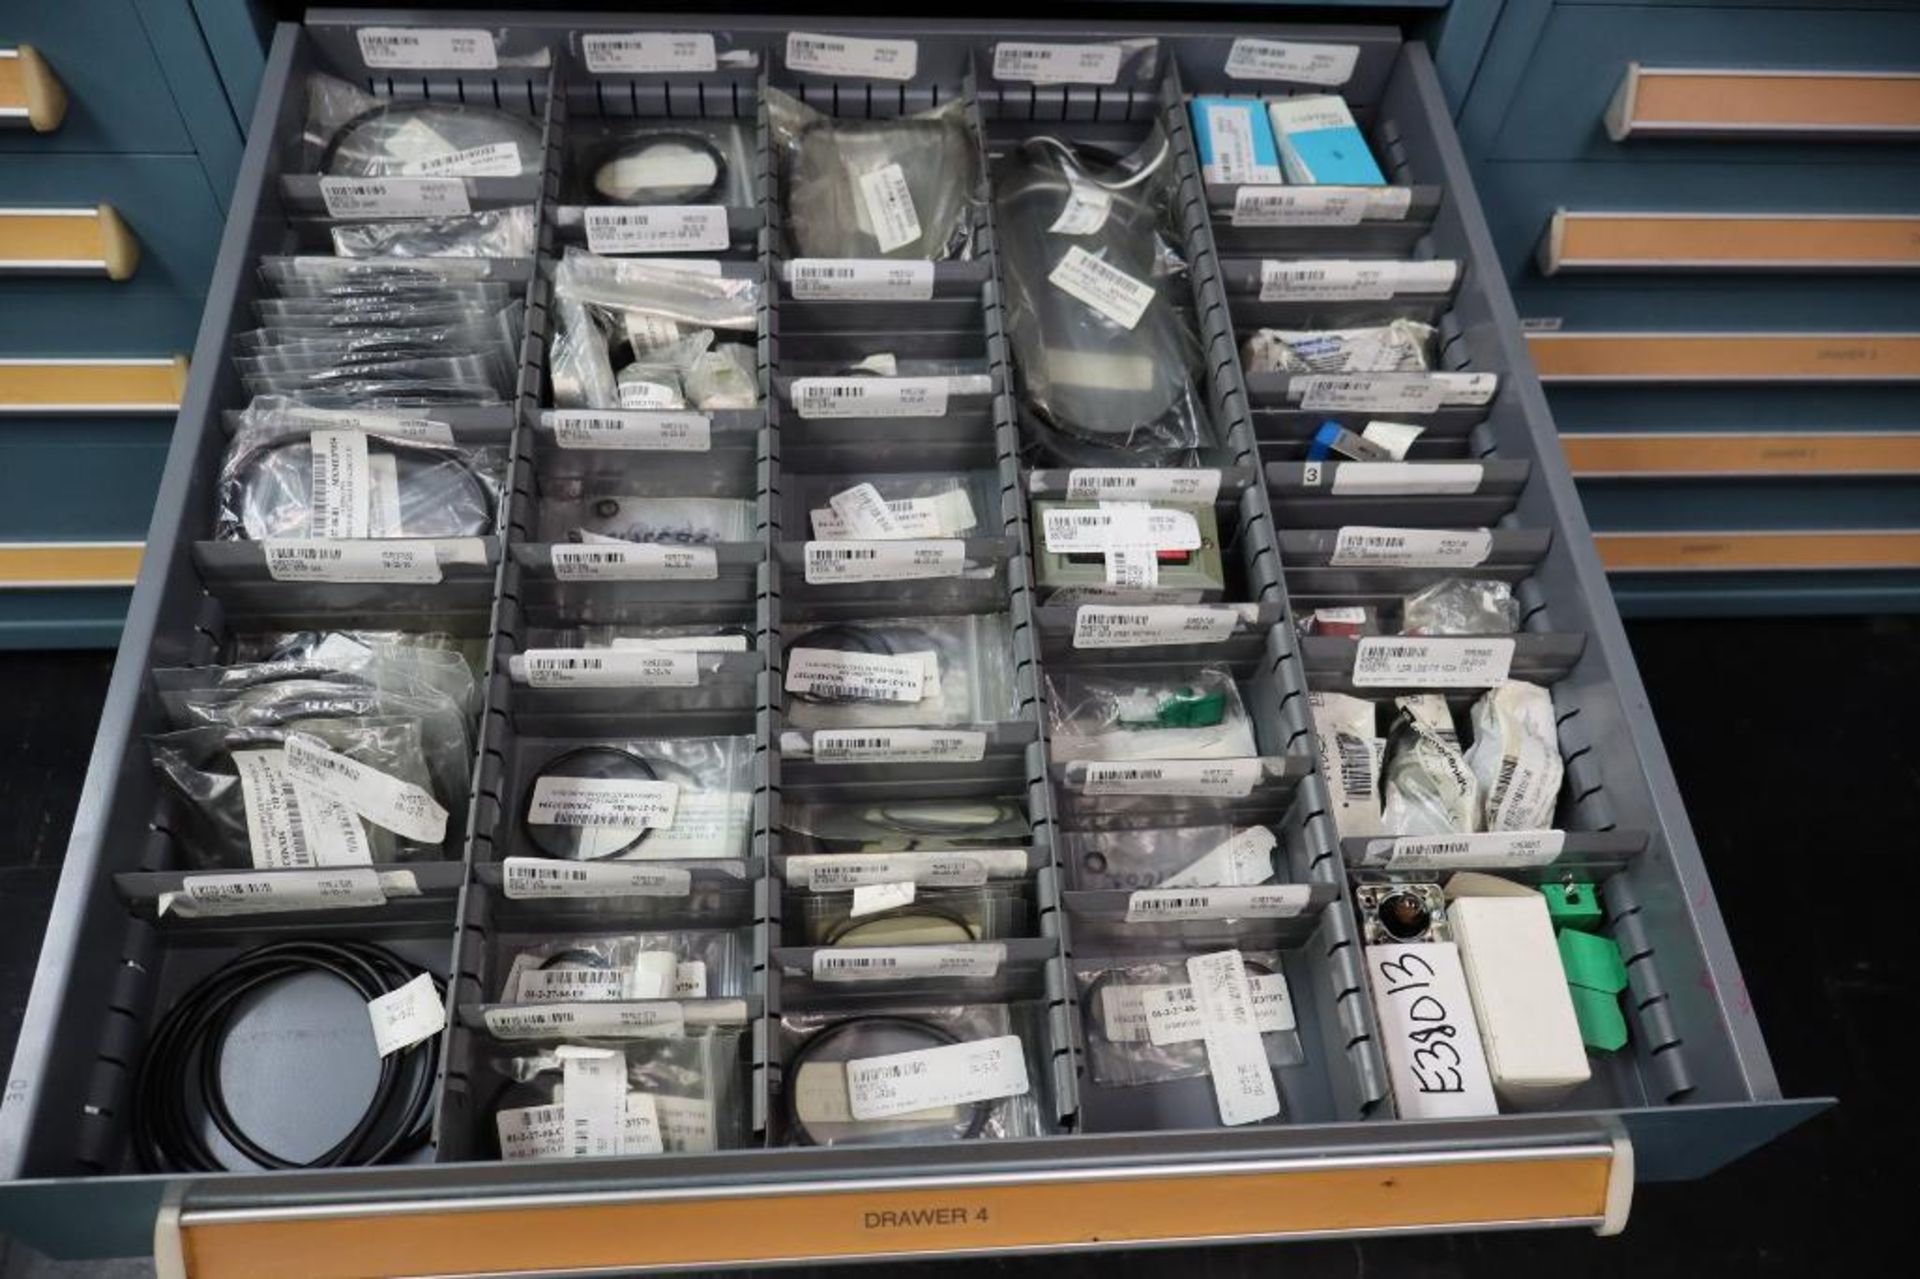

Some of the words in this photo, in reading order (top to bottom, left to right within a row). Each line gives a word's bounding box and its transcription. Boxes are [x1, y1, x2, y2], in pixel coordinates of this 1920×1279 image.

[1306, 467, 1318, 483] 3
[864, 1207, 968, 1229] DRAWER
[974, 1207, 989, 1223] 4
